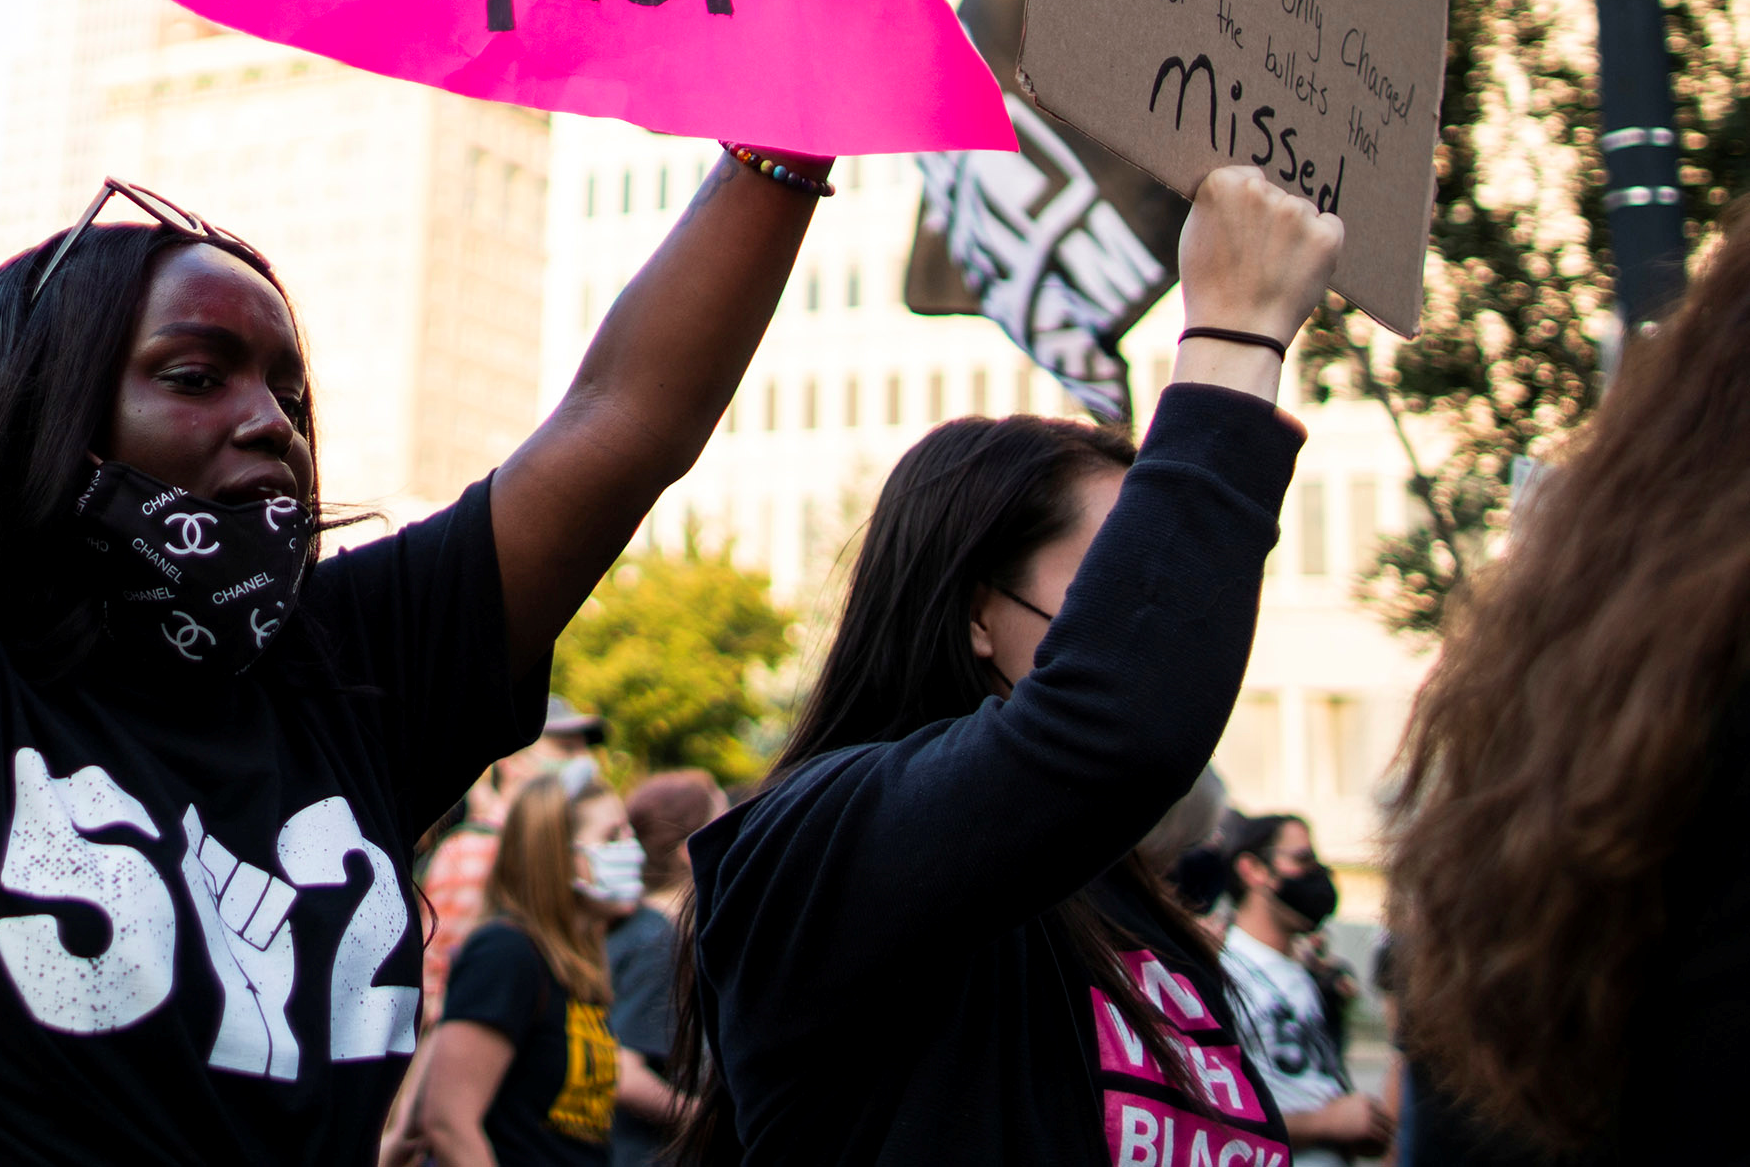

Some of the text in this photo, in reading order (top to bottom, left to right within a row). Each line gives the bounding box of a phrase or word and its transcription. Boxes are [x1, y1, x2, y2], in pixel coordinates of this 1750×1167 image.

[1149, 52, 1346, 215] Missed
[1264, 34, 1329, 116] bullets
[1347, 104, 1380, 166] that
[131, 537, 183, 585] CHANEL
[212, 571, 275, 606] CHANEL
